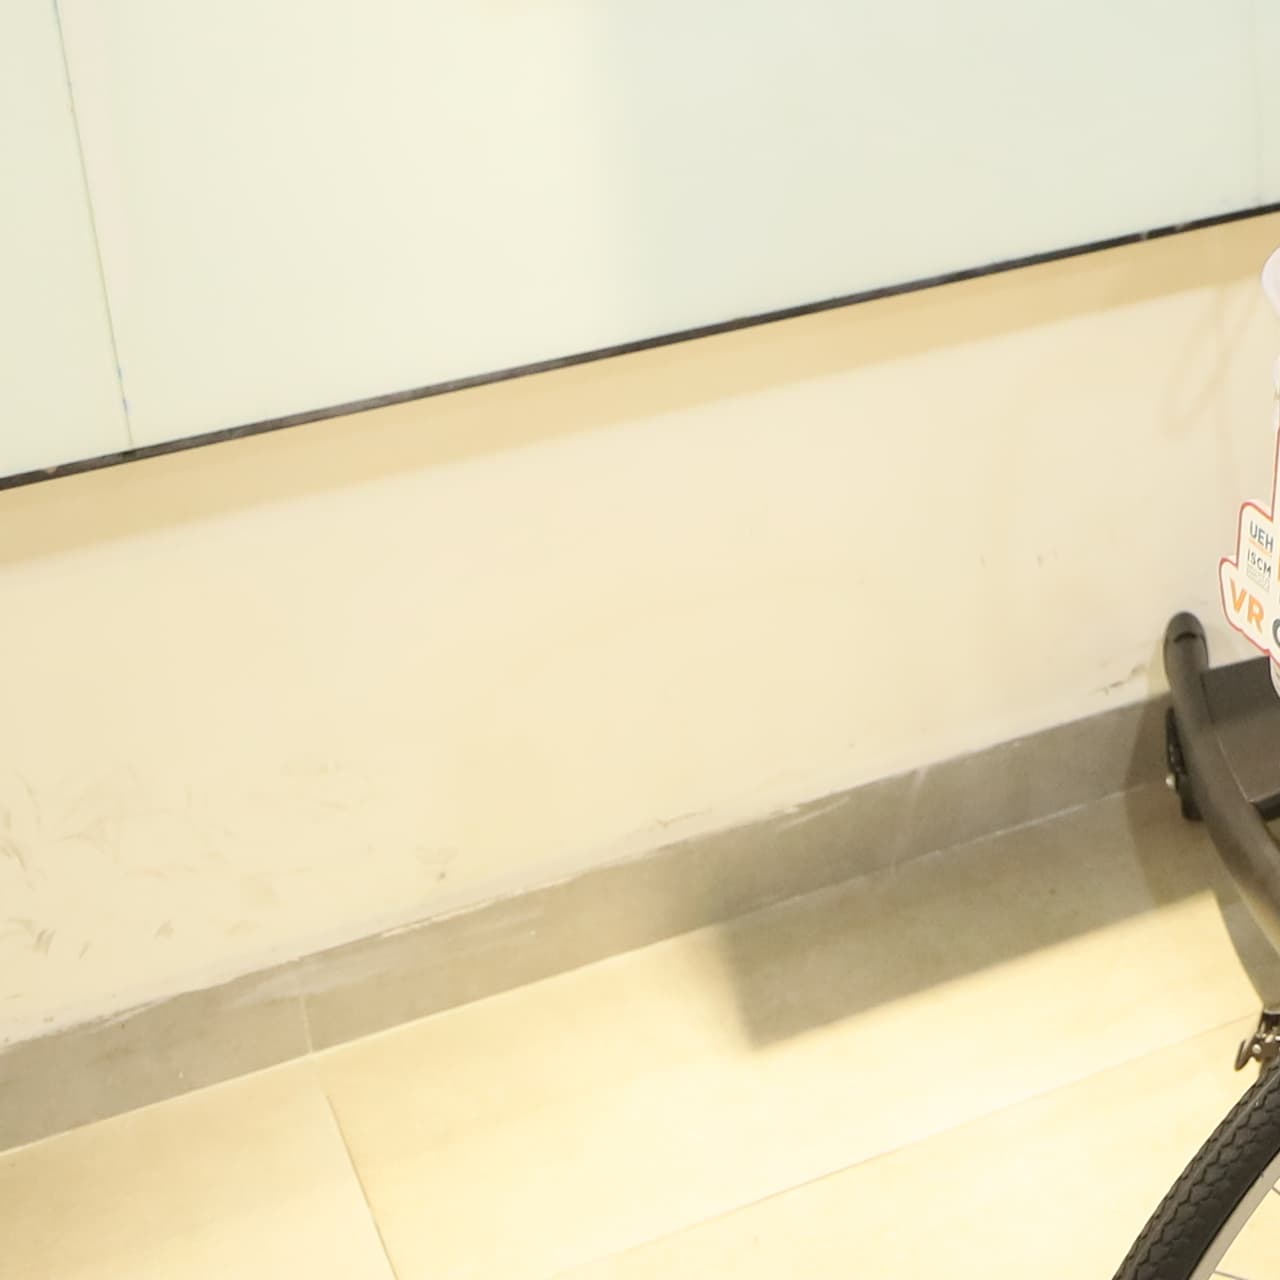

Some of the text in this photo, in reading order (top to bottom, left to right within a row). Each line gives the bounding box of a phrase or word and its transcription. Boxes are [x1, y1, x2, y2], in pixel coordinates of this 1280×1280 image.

[1249, 520, 1274, 552] UEH
[1247, 549, 1272, 578] ISCM
[1230, 577, 1264, 634] VR
